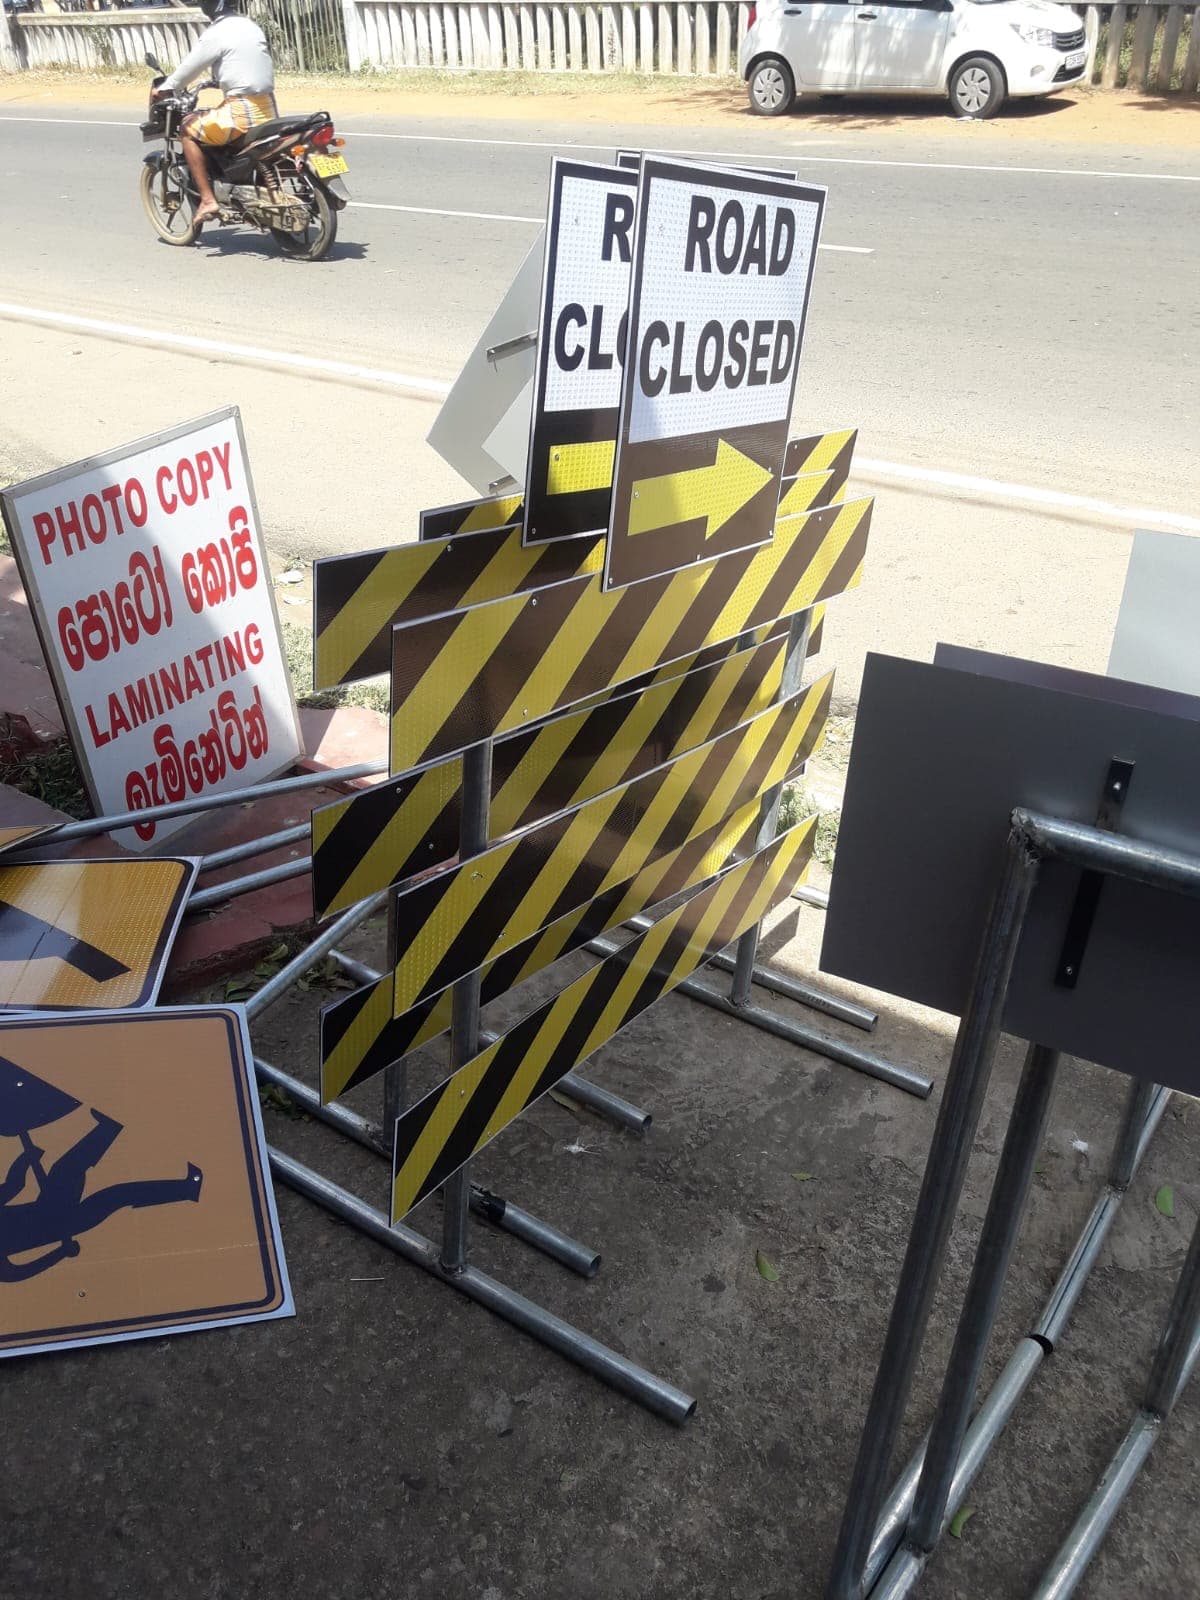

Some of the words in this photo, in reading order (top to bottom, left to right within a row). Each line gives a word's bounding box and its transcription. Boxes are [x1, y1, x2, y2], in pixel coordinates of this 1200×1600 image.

[684, 194, 796, 276] ROAD
[554, 302, 629, 371] CL
[639, 319, 795, 398] CLOSED
[33, 477, 148, 565] PHOTO
[156, 442, 232, 515] COPY
[84, 623, 265, 749] LAMINATING
